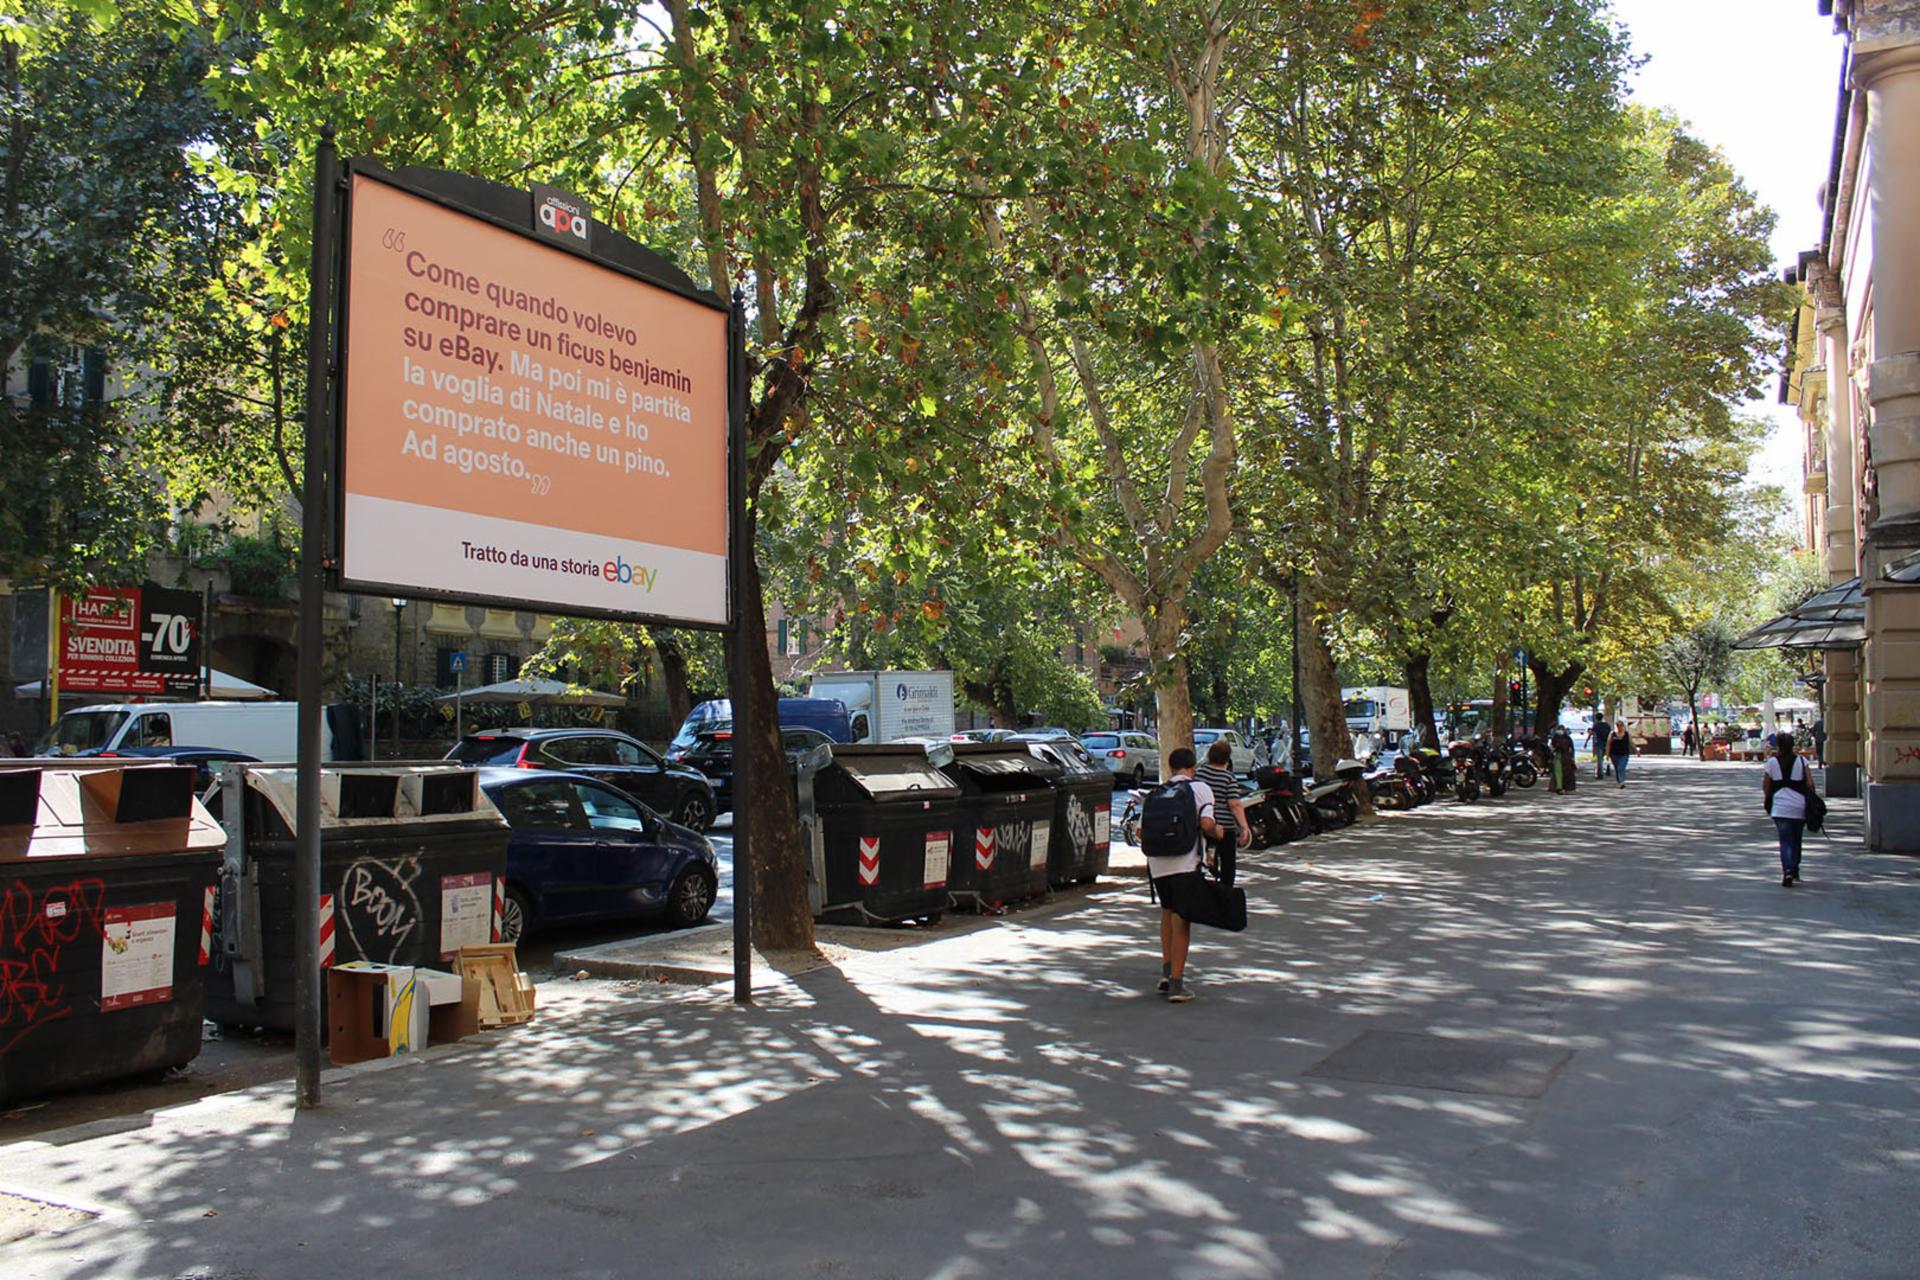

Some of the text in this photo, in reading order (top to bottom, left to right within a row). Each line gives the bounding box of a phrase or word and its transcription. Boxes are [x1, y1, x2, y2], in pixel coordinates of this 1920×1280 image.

[539, 203, 587, 240] apa
[406, 251, 637, 346] Come quando volevo
[403, 327, 691, 424] su eBay. Ma poi mi è partita
[404, 292, 691, 394] comprare un ficus benjamin
[403, 355, 649, 441] la voglia di Natale e ho
[402, 399, 671, 478] comprato anche un pino.
[402, 429, 532, 480] Ad agosto.
[461, 541, 600, 577] Tratto da una storia
[603, 555, 658, 593] ebay
[67, 636, 136, 655] SVENDITA
